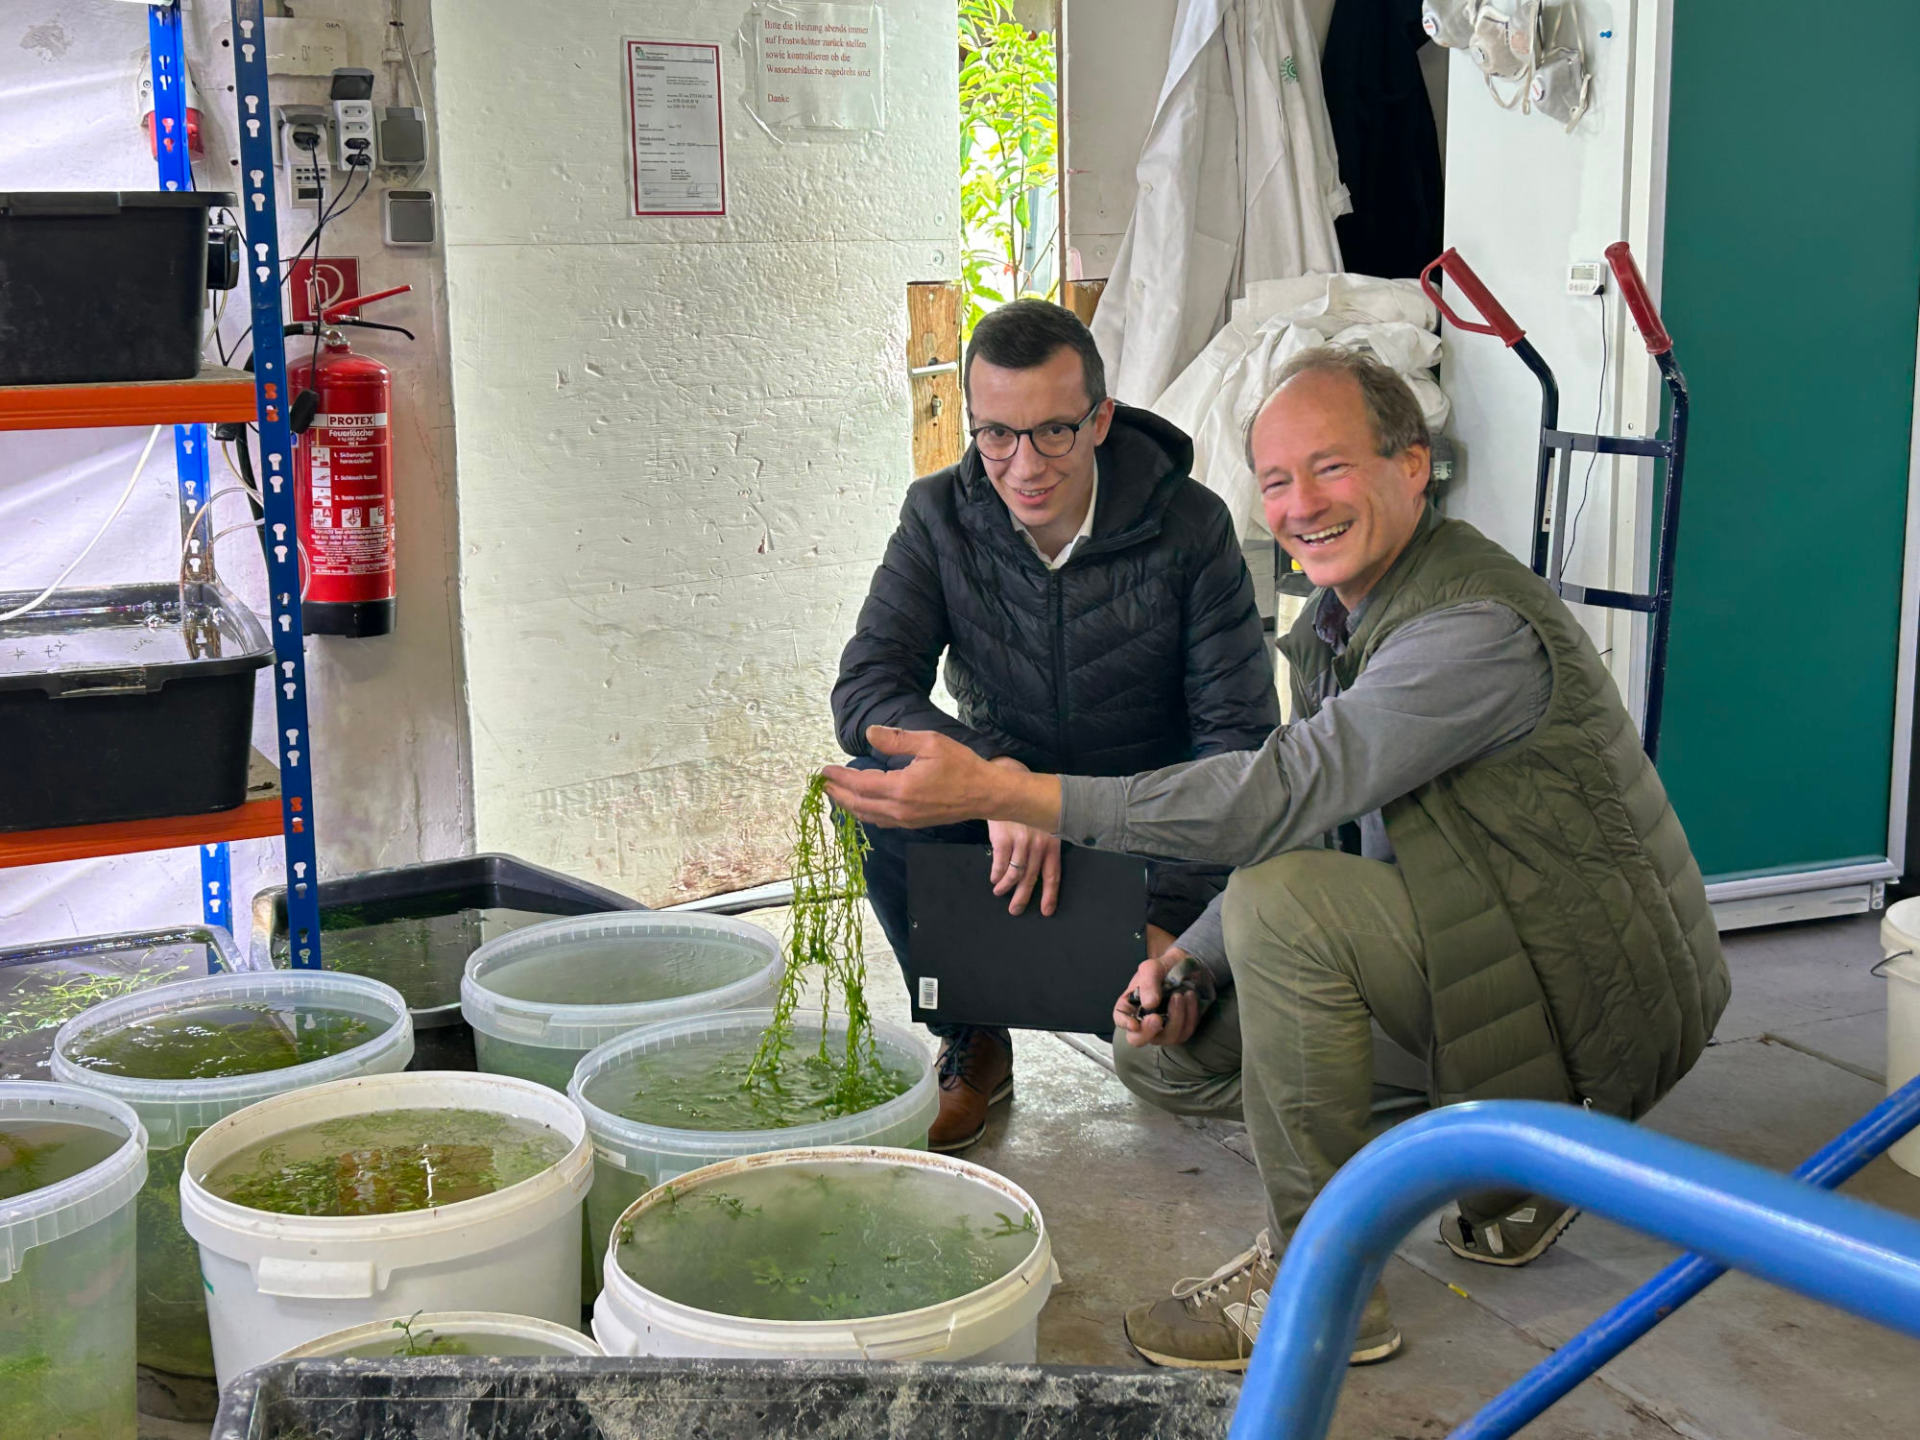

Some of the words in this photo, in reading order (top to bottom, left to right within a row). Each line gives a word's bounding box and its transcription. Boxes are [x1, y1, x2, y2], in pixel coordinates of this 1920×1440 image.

[764, 19, 781, 30] Bitte
[783, 21, 793, 30] die
[795, 21, 823, 33] Heizung
[824, 23, 847, 33] abends
[848, 24, 869, 34] immer
[765, 35, 777, 45] auf
[778, 36, 821, 46] Frostwächter
[846, 39, 867, 48] stellen
[765, 51, 785, 60] sowie
[787, 51, 829, 61] kontrollieren
[831, 52, 839, 61] ob
[841, 53, 851, 62] die
[857, 68, 871, 77] sind
[767, 93, 790, 103] Danke
[329, 416, 374, 425] PROTEX
[329, 429, 374, 437] Feuerlöscher
